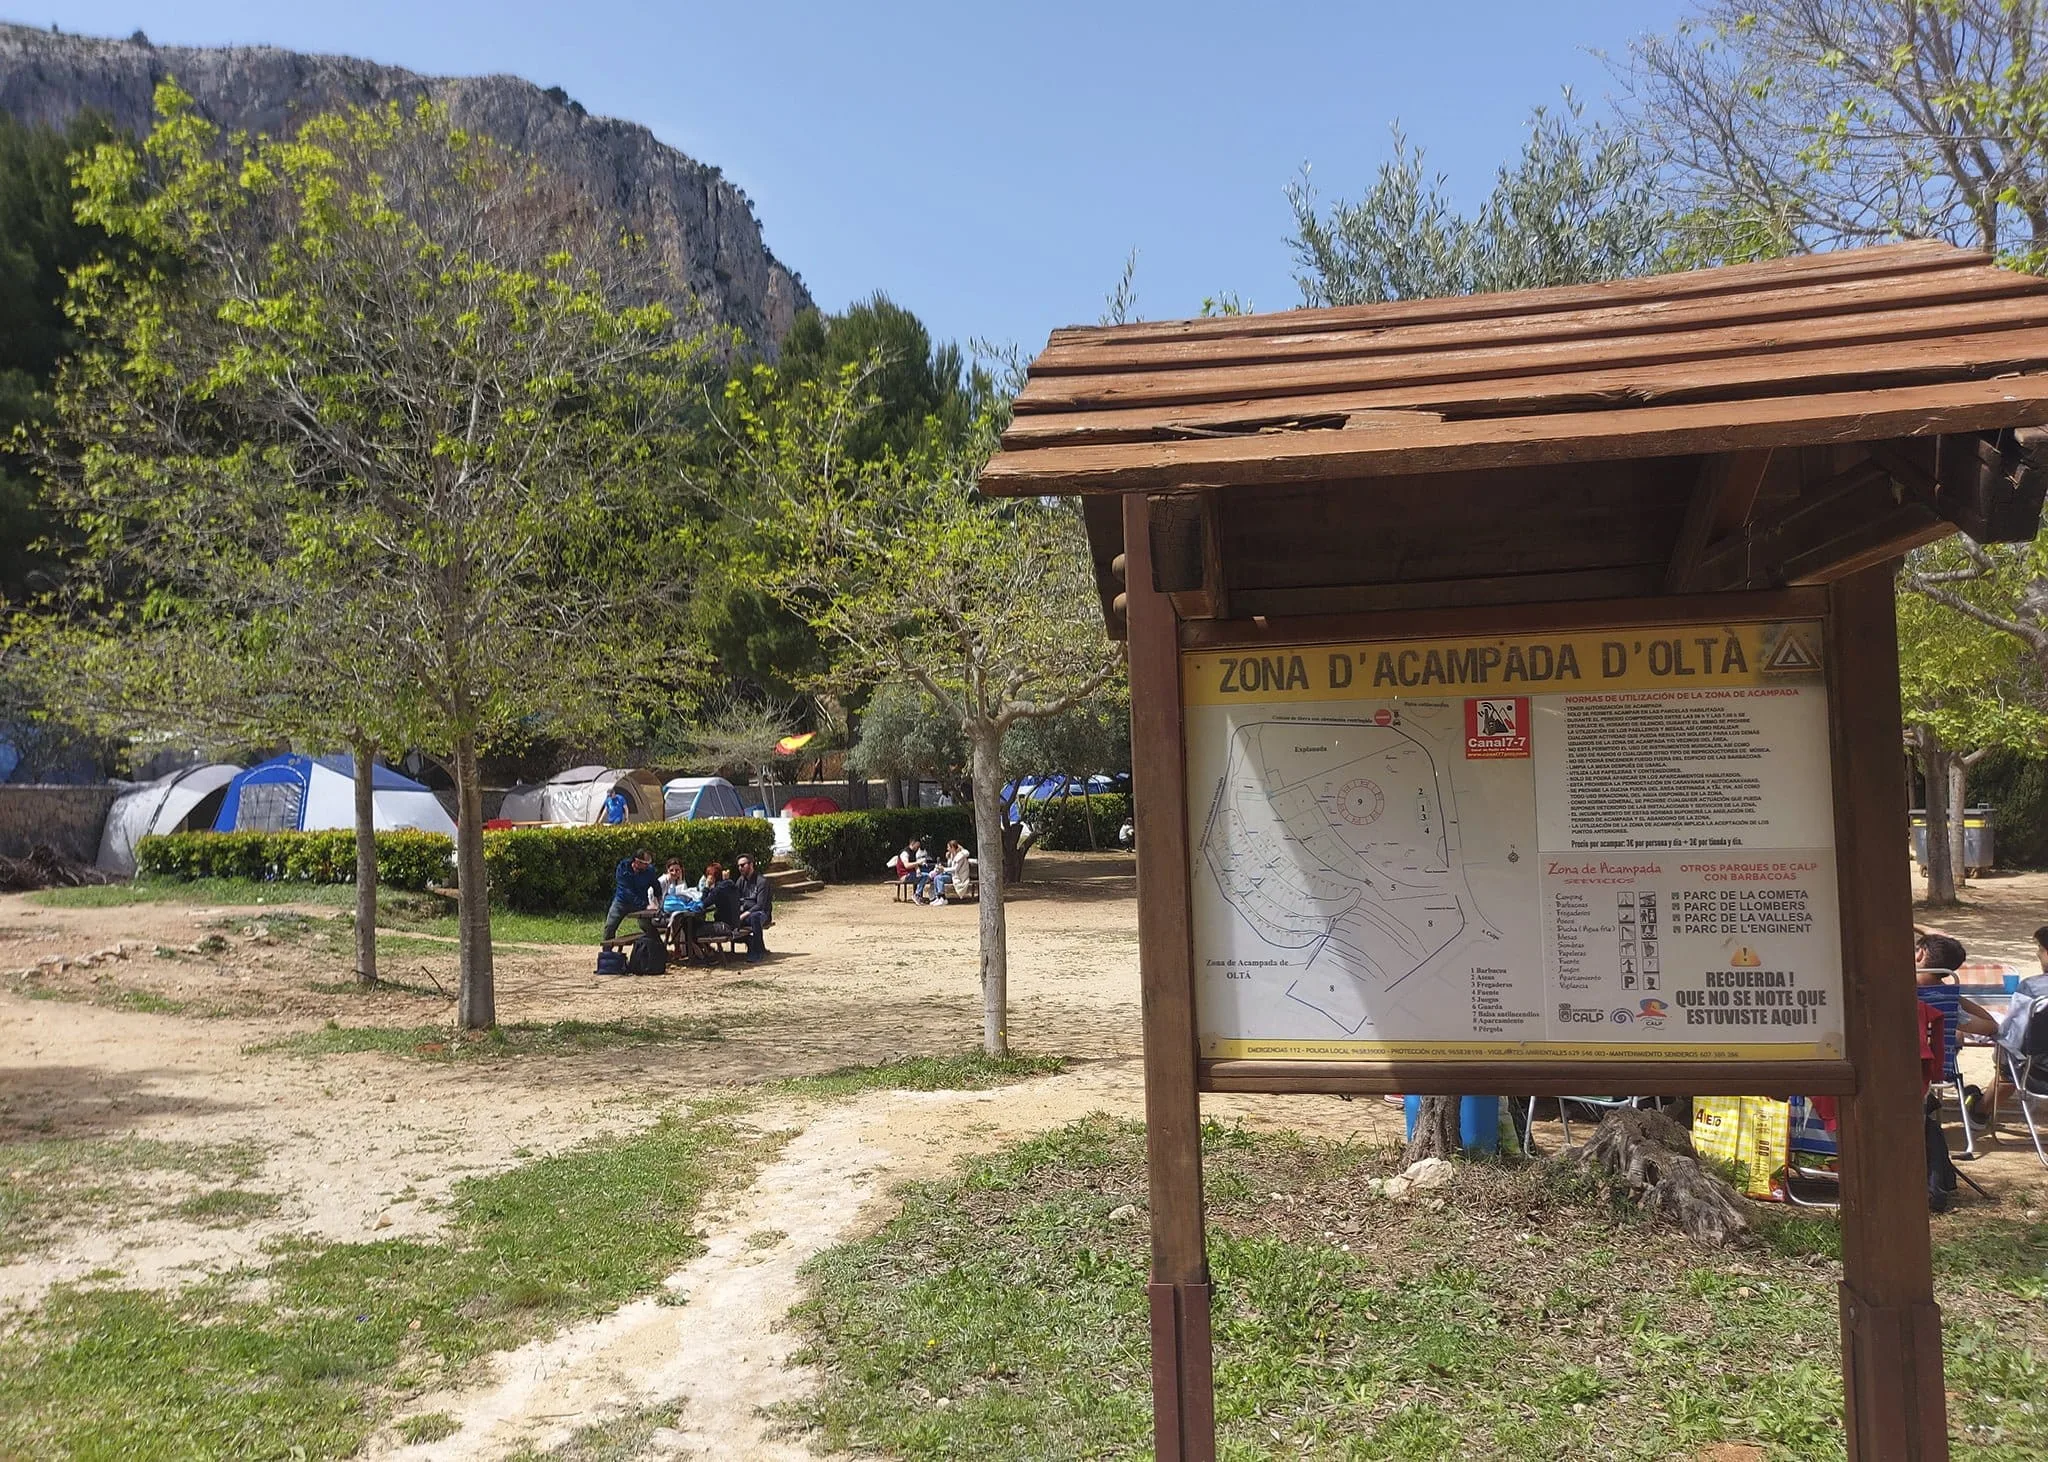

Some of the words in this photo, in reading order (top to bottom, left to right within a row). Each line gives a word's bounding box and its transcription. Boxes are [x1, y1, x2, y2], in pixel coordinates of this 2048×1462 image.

[1220, 656, 1309, 692] ZONA
[1329, 643, 1581, 689] D'ACAMPADA
[1602, 627, 1748, 679] D'OLTÀ
[1565, 695, 1603, 703] NORMAS
[1619, 691, 1674, 702] UTILIZACIÓN
[1705, 691, 1730, 699] ZONA
[1748, 689, 1798, 697] ACAMPADA
[1468, 737, 1526, 748] Canal7-7
[1571, 839, 1588, 848] Precio
[1590, 841, 1598, 849] por
[1600, 840, 1625, 848] acampar:
[1635, 840, 1644, 848] por
[1646, 840, 1667, 848] persona
[1668, 840, 1672, 848] y
[1698, 839, 1707, 847] por
[1709, 838, 1727, 846] tienda
[1728, 839, 1732, 847] y
[1548, 862, 1578, 874] Zona
[1582, 862, 1596, 874] de
[1600, 861, 1662, 876] Acampada
[1680, 864, 1717, 872] OTROS
[1720, 864, 1769, 873] PARQUES
[1772, 863, 1786, 871] DE
[1790, 863, 1817, 871] CALP
[1731, 873, 1797, 881] BARBACOAS
[1556, 892, 1583, 901] Camping
[1683, 891, 1716, 900] PARC
[1720, 891, 1736, 900] DE
[1740, 891, 1755, 899] LA
[1758, 890, 1809, 900] COMETA
[1684, 902, 1717, 911] PARC
[1720, 902, 1736, 911] DE
[1740, 902, 1805, 911] LLOMBERS
[1556, 909, 1591, 917] Fregaderos
[1685, 913, 1717, 922] PARC
[1721, 913, 1737, 922] DE
[1740, 913, 1755, 922] LA
[1758, 912, 1813, 922] VALLESA
[1685, 925, 1718, 934] PARC
[1721, 924, 1737, 933] DE
[1741, 924, 1812, 933] L'ENGINENT
[1206, 959, 1225, 967] Zona
[1239, 960, 1279, 968] Acampada
[1625, 977, 1635, 988] P
[1706, 972, 1786, 988] RECUERDA
[1789, 971, 1794, 987] !
[1560, 982, 1588, 990] Vigilancia
[1676, 991, 1705, 1008] QUE
[1709, 991, 1729, 1006] NO
[1733, 990, 1751, 1006] SE
[1755, 990, 1793, 1006] NOTE
[1797, 990, 1827, 1007] QUE
[1573, 1013, 1604, 1022] CALP
[1687, 1009, 1769, 1025] ESTUVISTE
[1812, 1009, 1817, 1024] !
